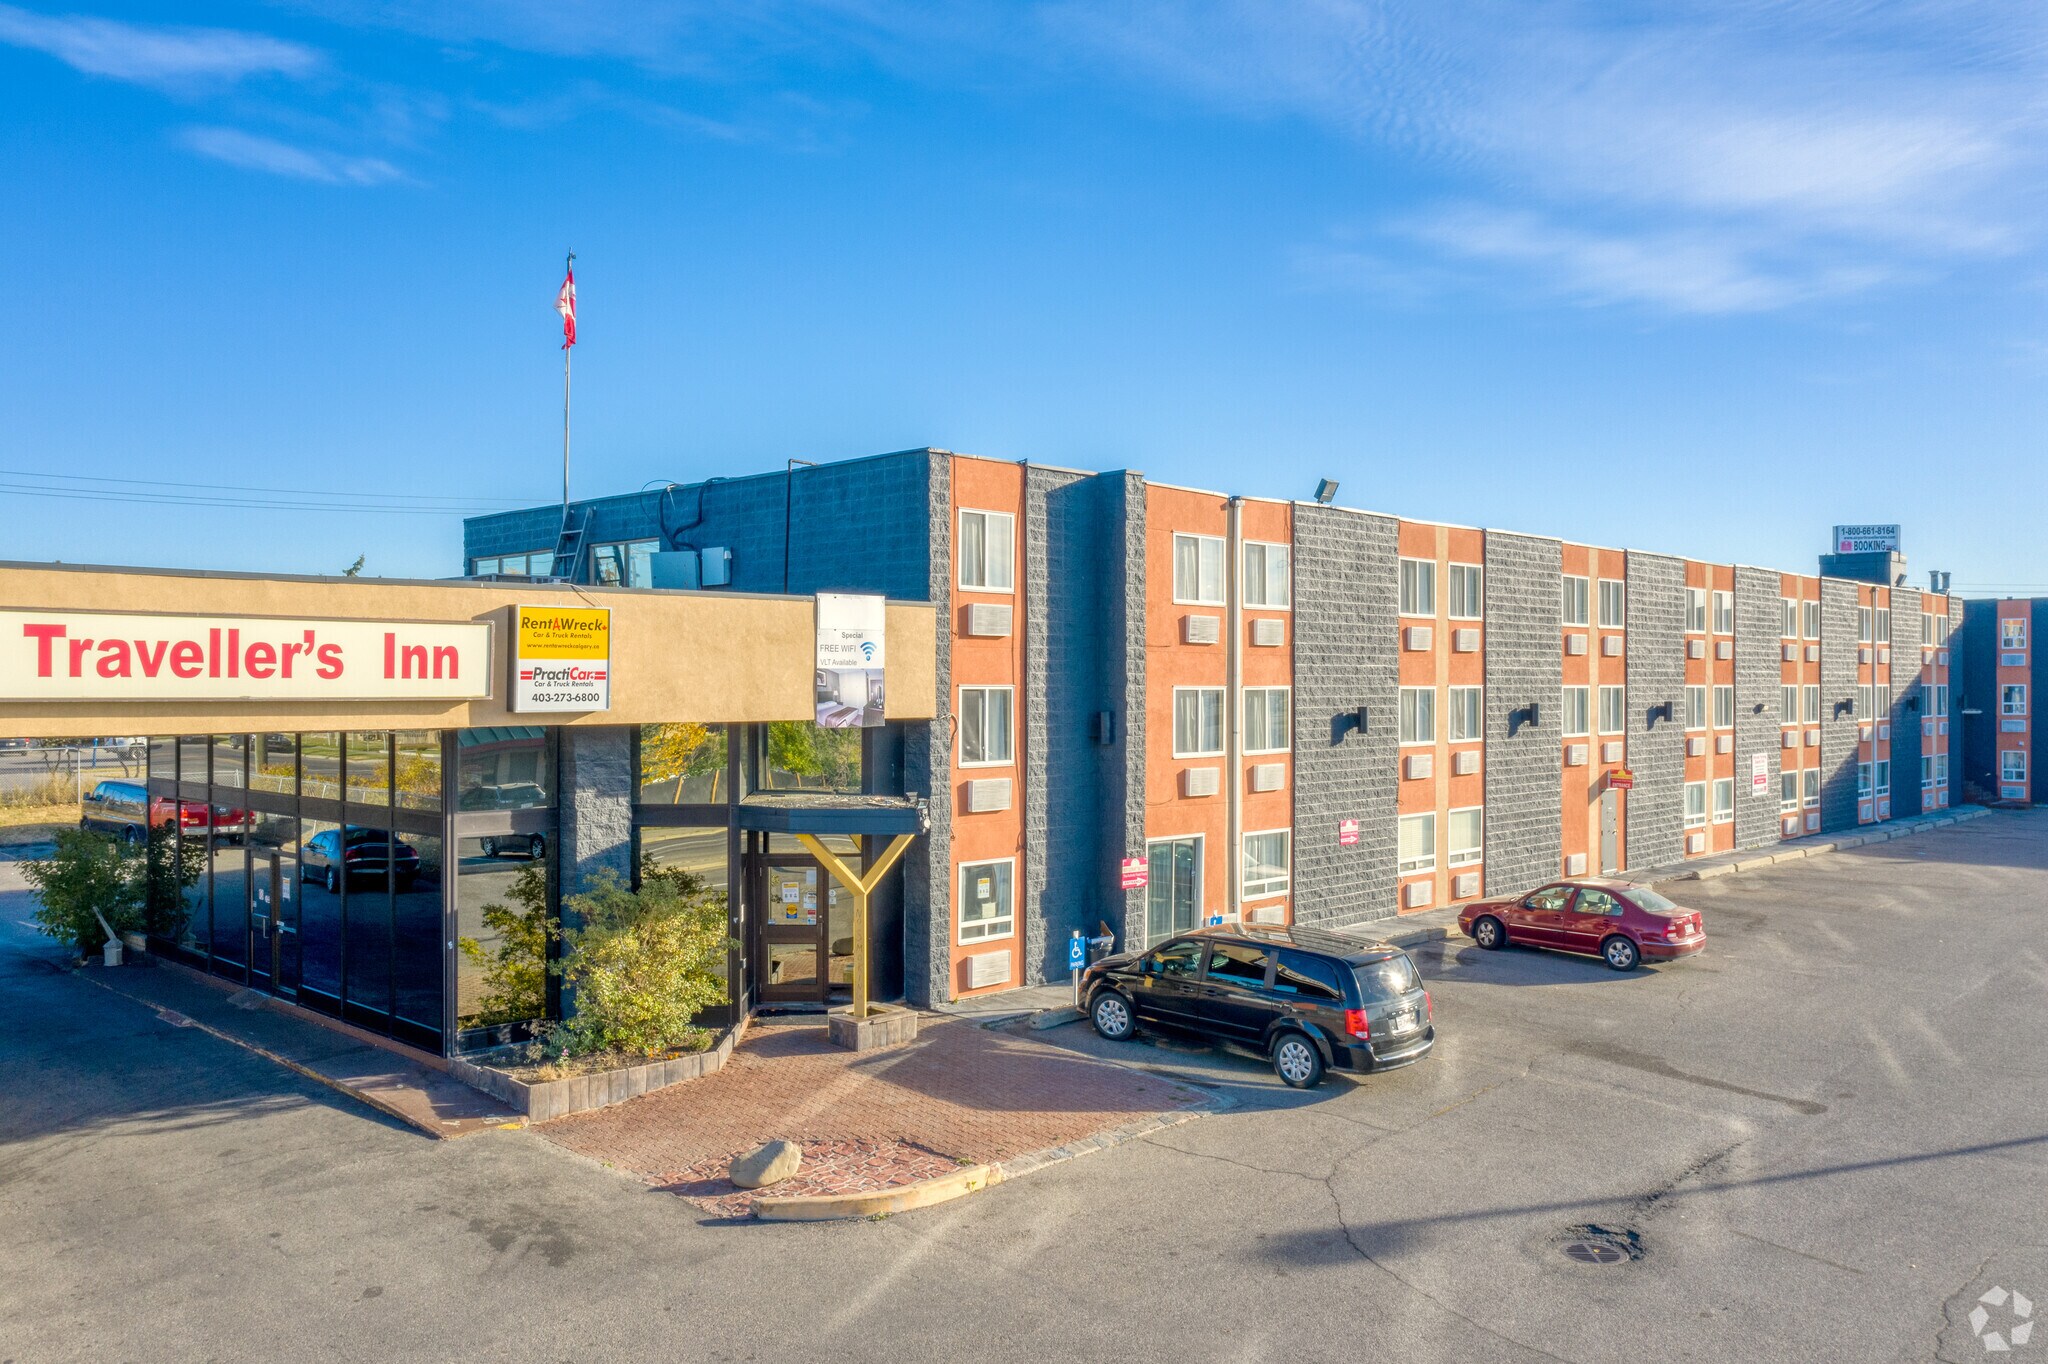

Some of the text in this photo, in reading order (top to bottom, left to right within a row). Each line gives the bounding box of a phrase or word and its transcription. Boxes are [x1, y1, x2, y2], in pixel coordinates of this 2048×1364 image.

[1841, 526, 1895, 535] 1-800-661-8164
[1853, 541, 1886, 551] BOOKING
[23, 623, 460, 680] Traveller's Inn
[820, 644, 839, 652] FREE
[533, 666, 591, 681] PractiCar
[531, 693, 600, 703] 403-273-6800
